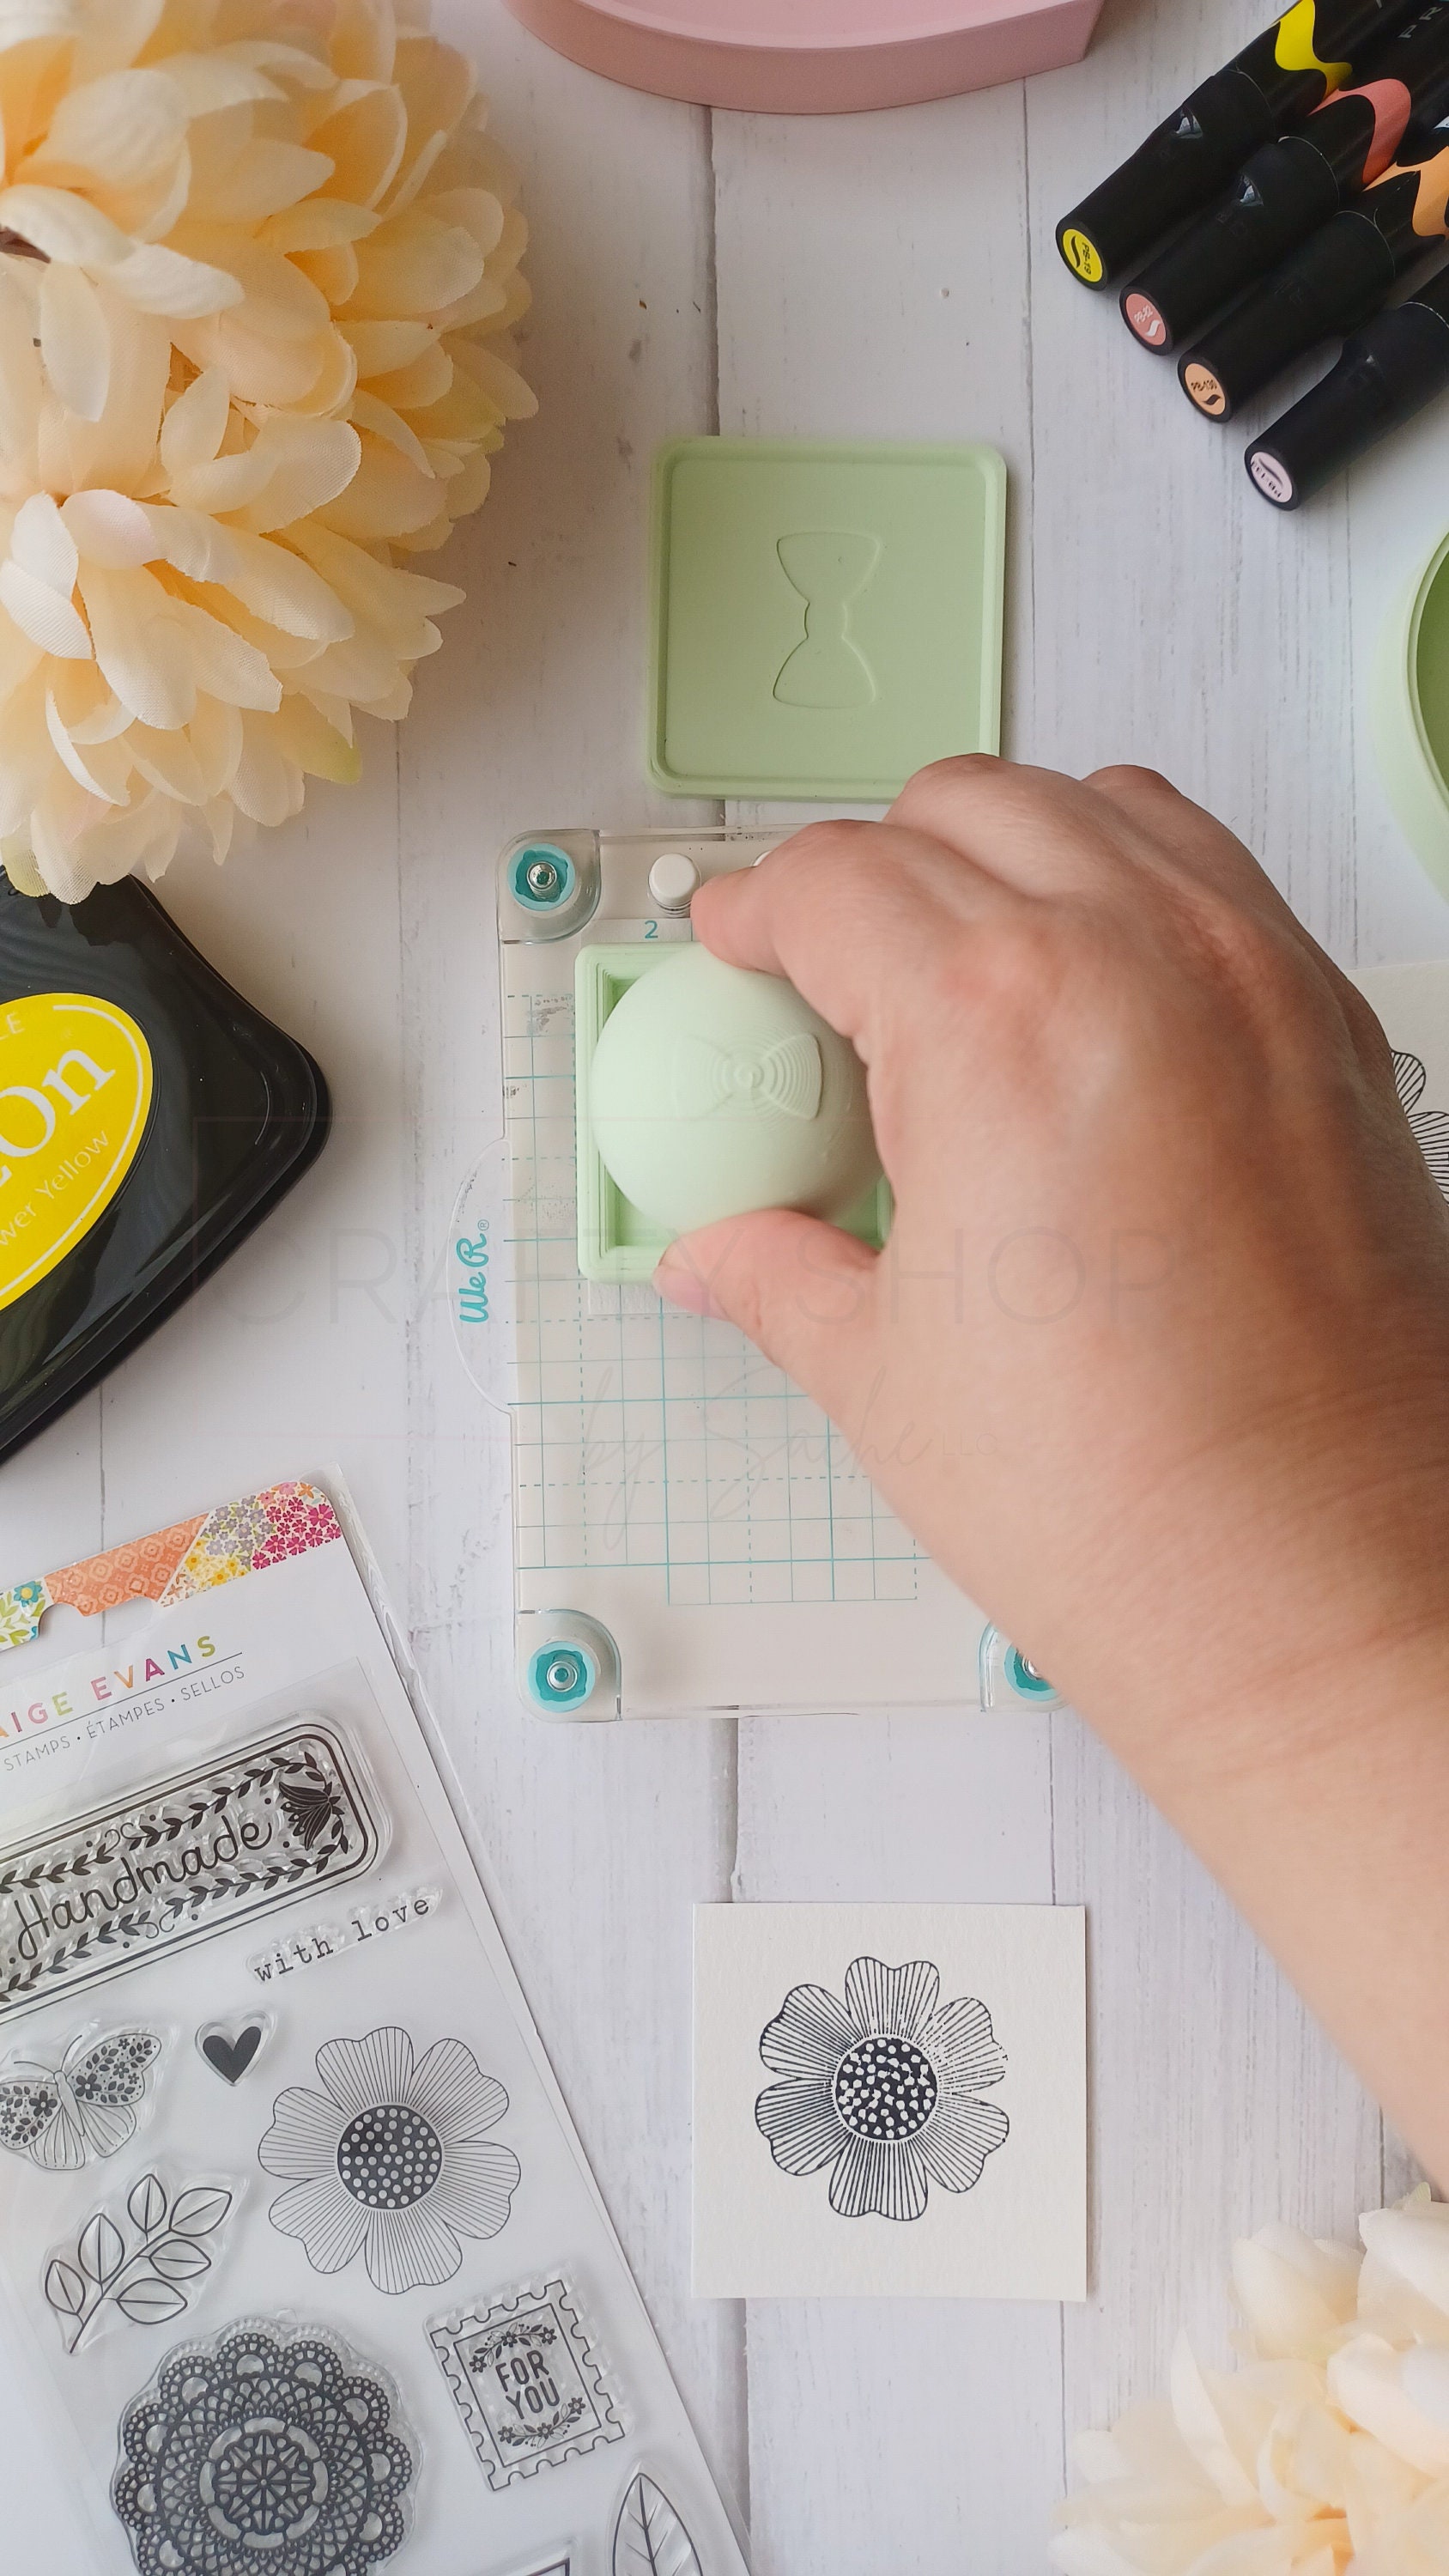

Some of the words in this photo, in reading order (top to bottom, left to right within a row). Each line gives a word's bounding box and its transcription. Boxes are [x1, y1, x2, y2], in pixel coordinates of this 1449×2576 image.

[645, 920, 659, 939] 2
[0, 1049, 116, 1187] On
[34, 1130, 109, 1200] Yellow
[458, 1272, 488, 1323] We
[0, 1692, 74, 1738] IGE
[90, 1635, 216, 1701] EVANS
[4, 1736, 70, 1771] STAMPS
[86, 1698, 166, 1740] ÉTAMPES
[180, 1666, 245, 1701] SELLOS
[14, 1815, 272, 1960] Handmade
[254, 1936, 334, 1983] with
[351, 1897, 430, 1942] love
[495, 2349, 549, 2392] FOR
[505, 2378, 560, 2420] YOU
